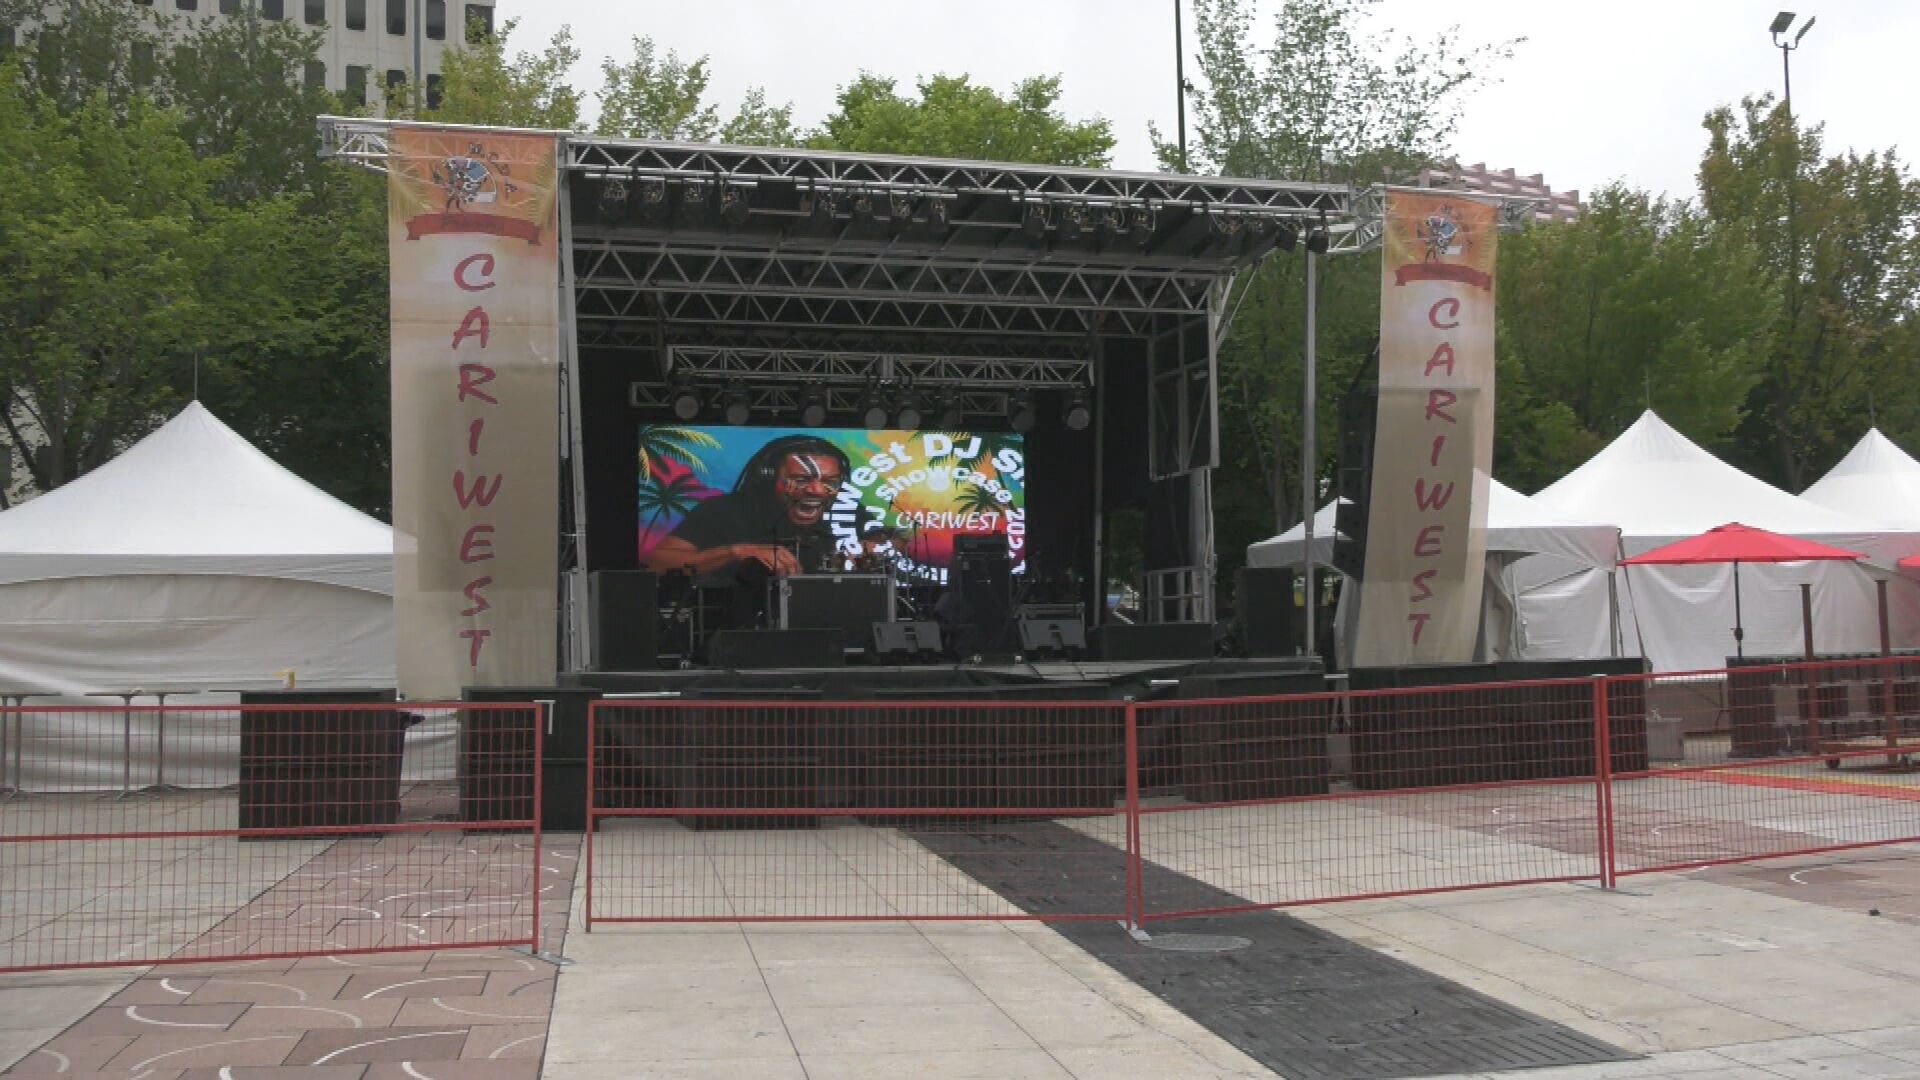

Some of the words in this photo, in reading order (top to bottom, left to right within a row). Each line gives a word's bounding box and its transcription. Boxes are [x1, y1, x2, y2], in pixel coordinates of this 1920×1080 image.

[452, 253, 502, 667] CARIWEST
[896, 510, 1000, 532] CARIWEST
[923, 433, 982, 458] DJ
[1408, 298, 1461, 645] CARIWEST
